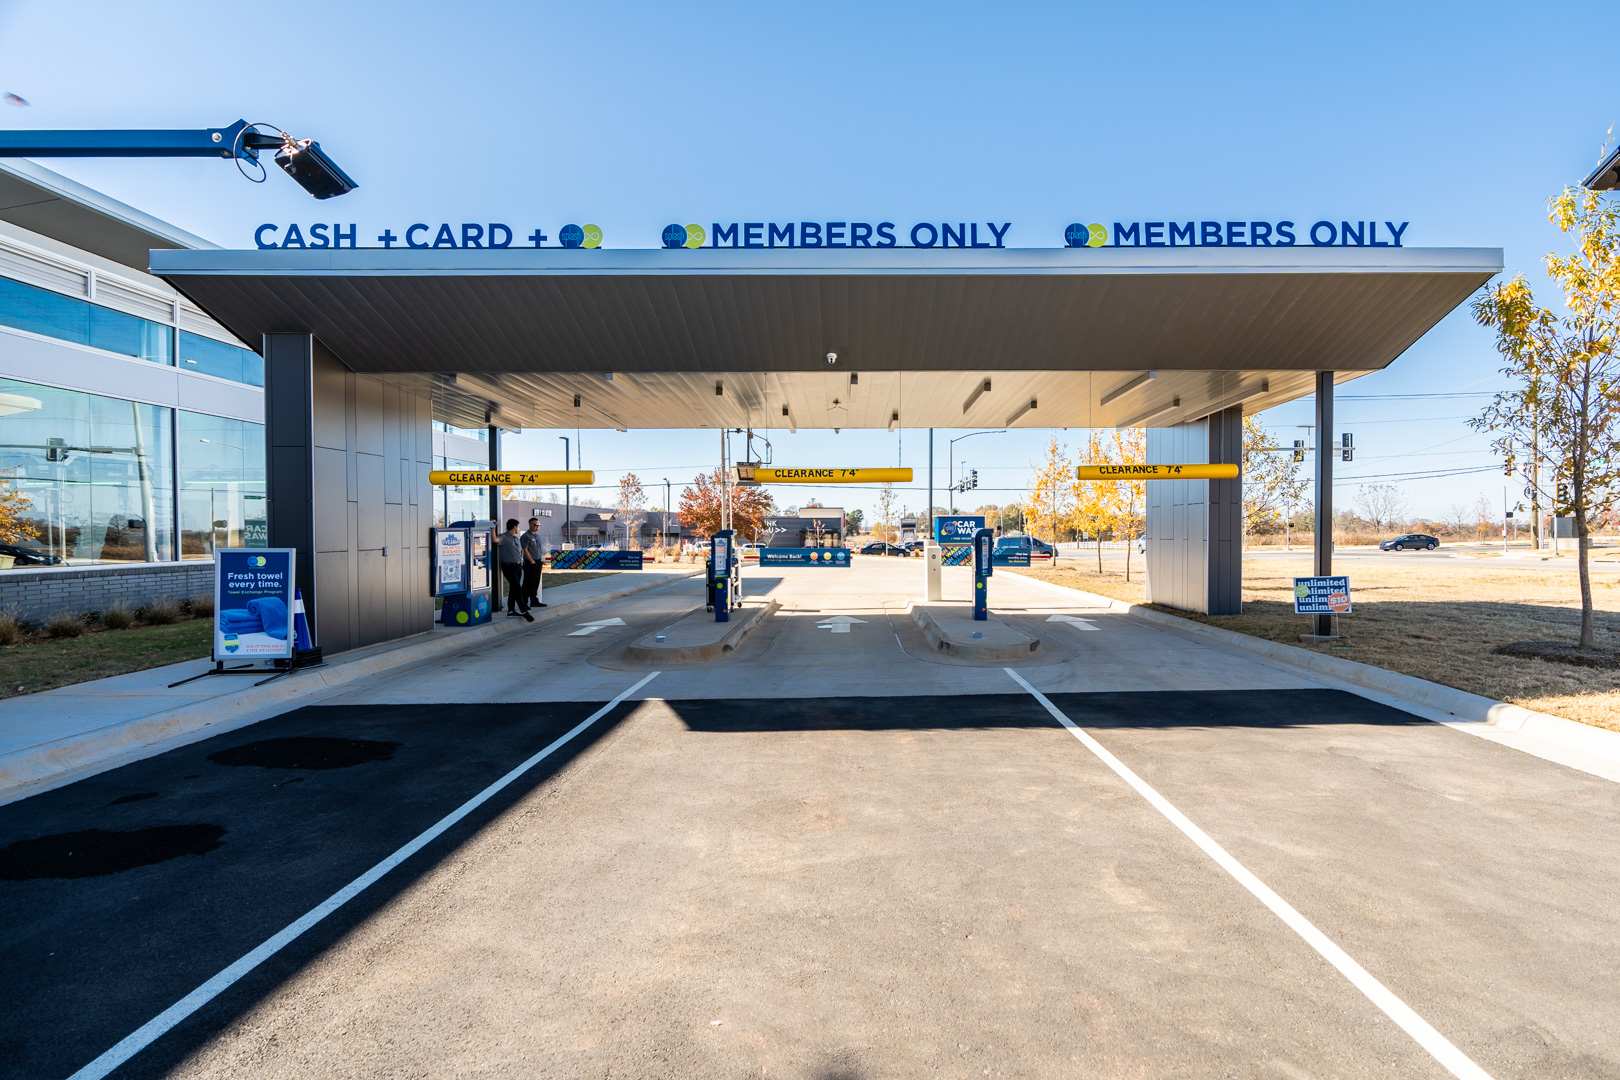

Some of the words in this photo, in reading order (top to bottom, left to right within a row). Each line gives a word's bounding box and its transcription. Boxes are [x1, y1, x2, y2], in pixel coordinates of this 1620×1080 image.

[254, 223, 357, 250] CASH
[405, 223, 513, 250] CARD
[712, 222, 896, 249] MEMBERS
[910, 222, 1012, 248] ONLY
[1113, 221, 1296, 248] MEMBERS
[1310, 221, 1410, 247] ONLY
[774, 469, 834, 478] CLEARANCE
[841, 468, 860, 477] 7'4"
[1099, 466, 1159, 475] CLEARANCE
[1166, 465, 1183, 474] 7'4"
[449, 473, 511, 483] CLEARANCE
[519, 473, 539, 483] 7'4"
[957, 520, 976, 528] CAR
[957, 527, 979, 535] WAS
[227, 572, 255, 580] Fresh
[256, 571, 283, 580] towel
[228, 581, 255, 589] every
[258, 580, 282, 588] time.
[1298, 579, 1346, 587] unlimited
[1299, 595, 1330, 603] unlim
[1330, 596, 1348, 605] $10
